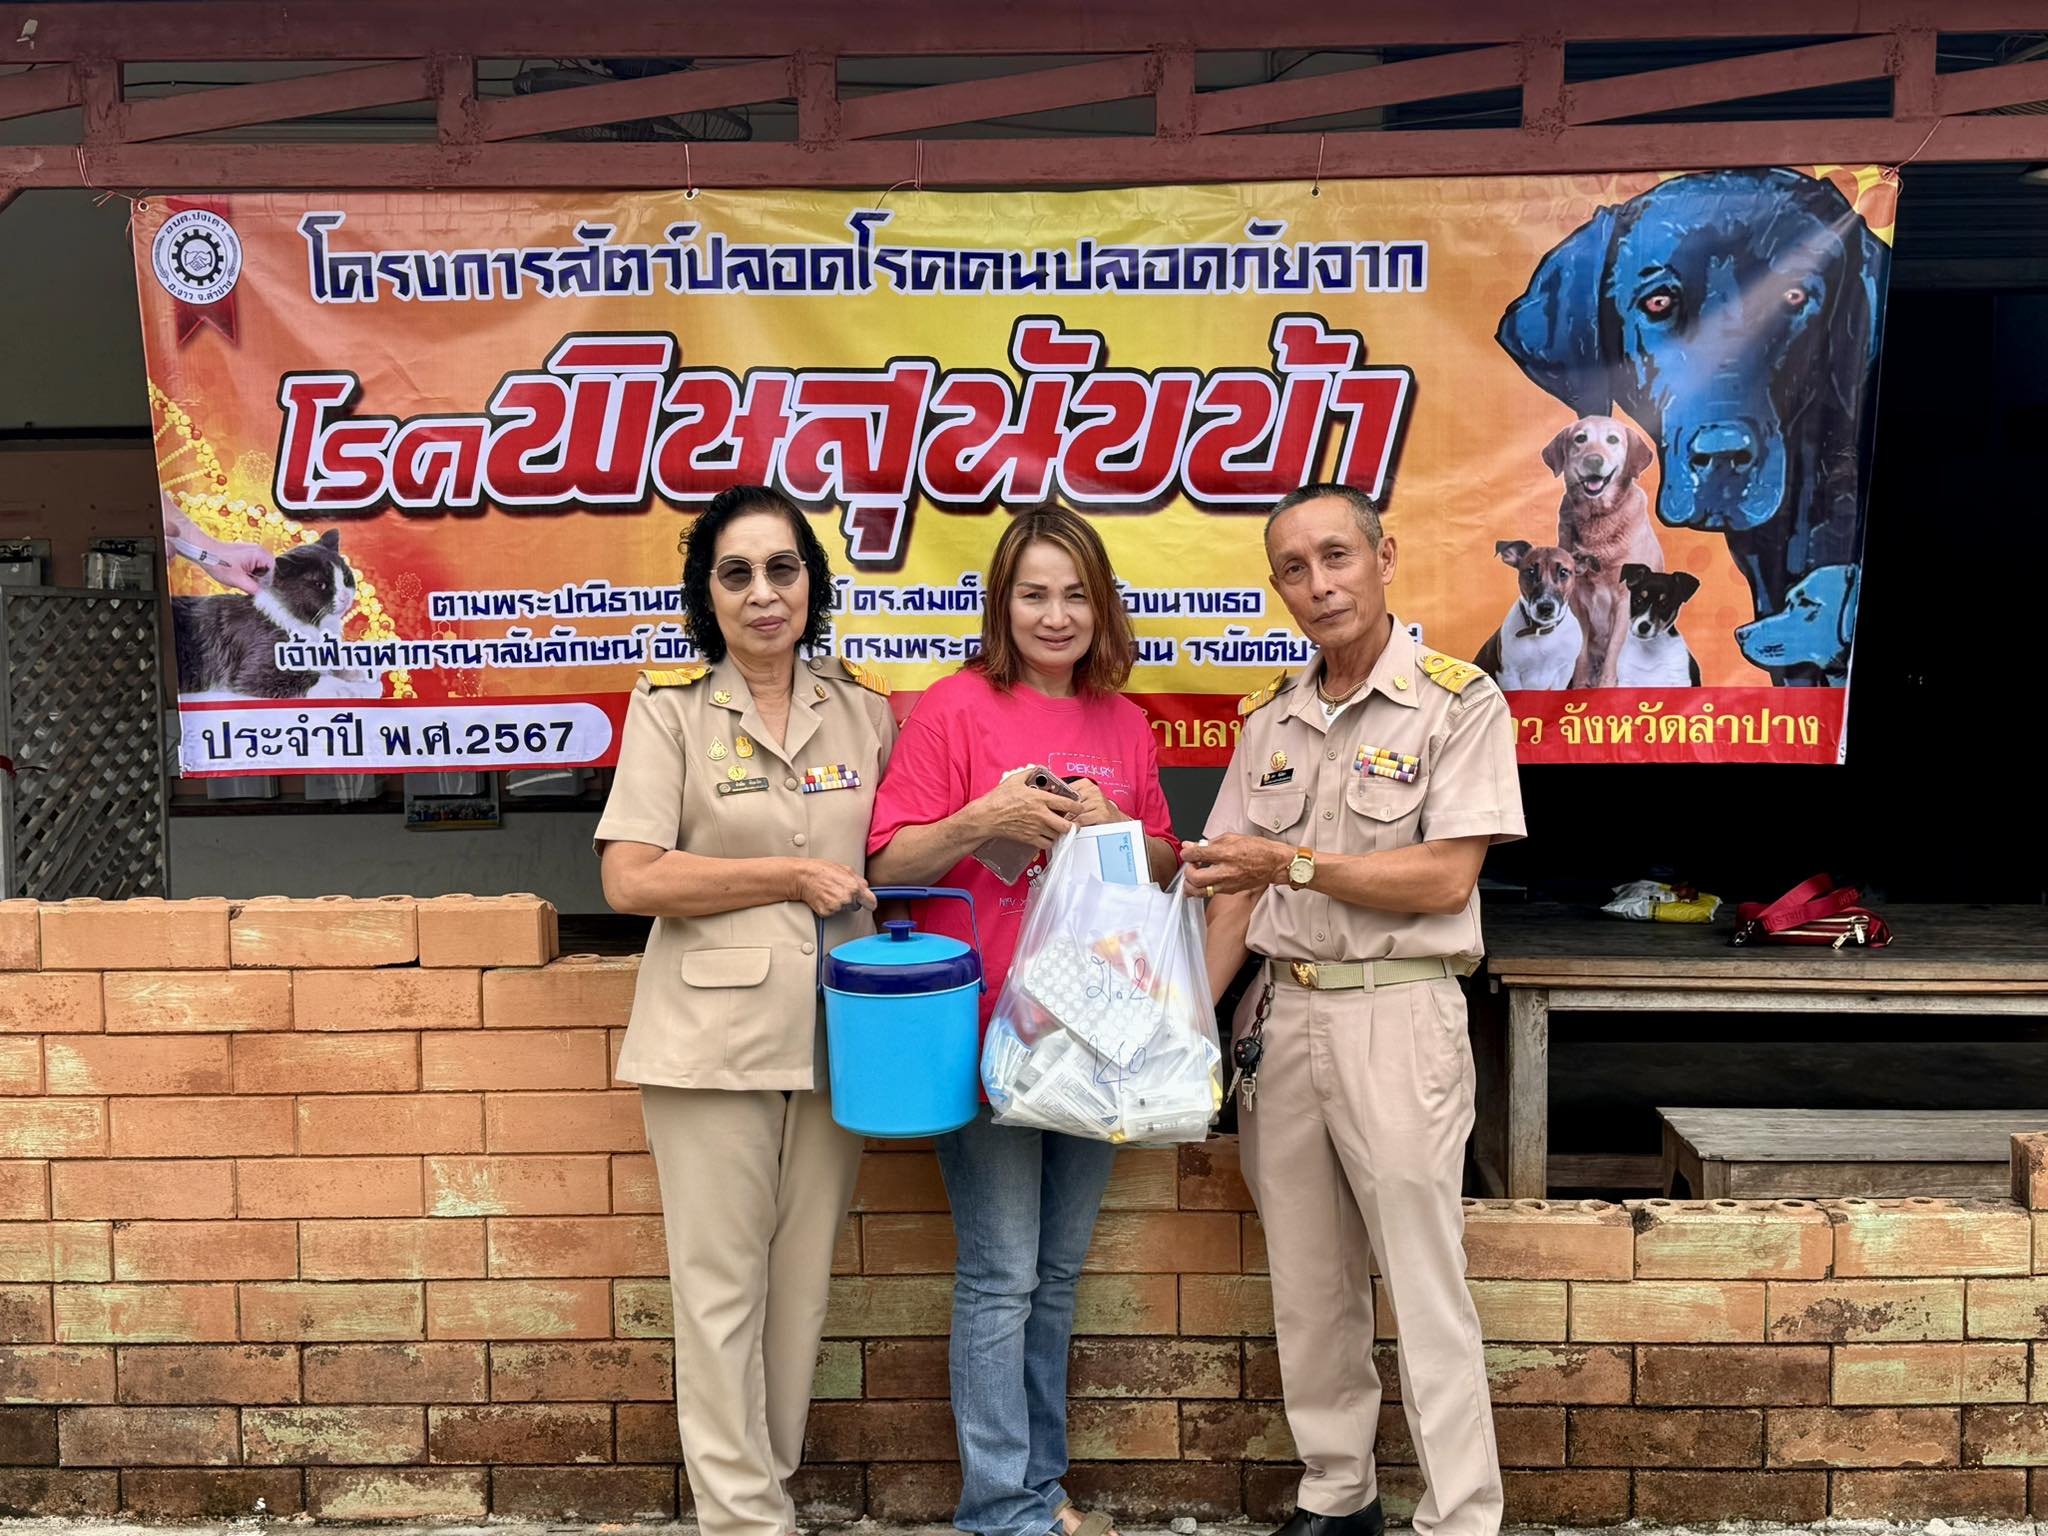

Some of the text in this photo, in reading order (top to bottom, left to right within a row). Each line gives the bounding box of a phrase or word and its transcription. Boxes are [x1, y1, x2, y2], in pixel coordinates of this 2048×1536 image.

[301, 211, 1426, 300] โครงการสัตว์ปลอดโรคคนปลอดภัยจาก
[202, 711, 364, 760] ประจำปี
[379, 720, 574, 757] พ.ศ.2567
[1558, 700, 1819, 746] จังหวัดลำปาง
